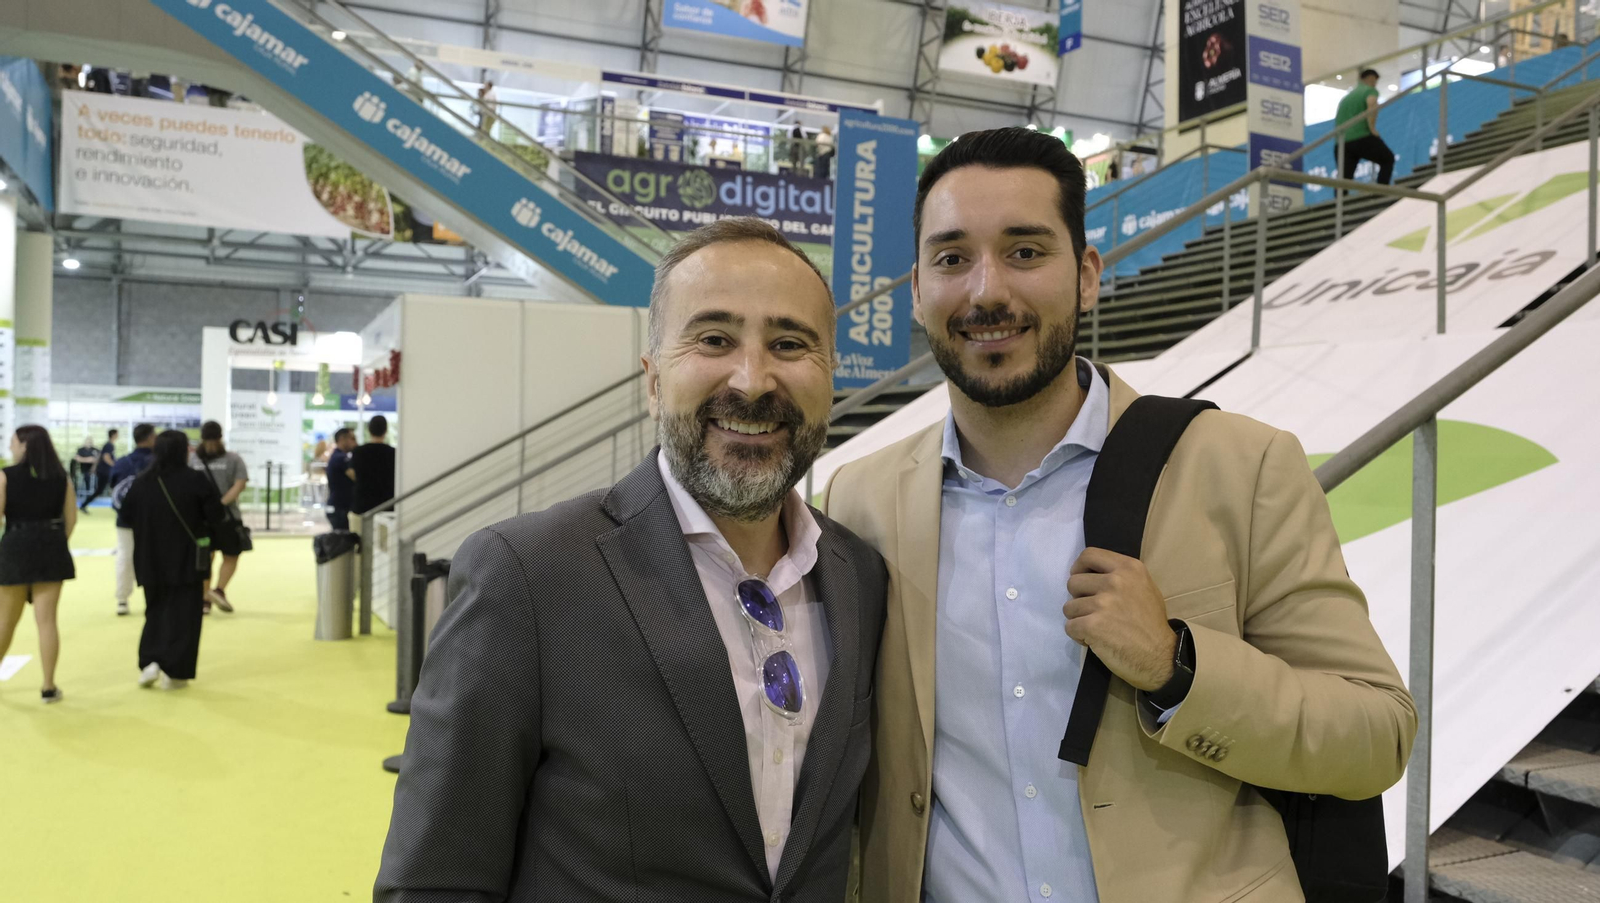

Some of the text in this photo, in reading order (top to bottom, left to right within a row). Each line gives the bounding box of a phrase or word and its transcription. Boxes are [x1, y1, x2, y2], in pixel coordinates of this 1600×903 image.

[214, 3, 309, 68] cajamar
[1259, 50, 1292, 73] SER
[78, 104, 91, 118] A
[97, 109, 154, 128] veces
[159, 117, 229, 138] puedes
[1261, 99, 1292, 119] SER
[76, 147, 184, 173] rendimiento
[386, 117, 472, 179] cajamar
[75, 167, 88, 182] e
[719, 175, 834, 217] digital
[782, 220, 809, 235] DEL
[848, 139, 878, 347] AGRICULTURA
[541, 222, 619, 279] cajamar
[228, 318, 299, 347] CASI
